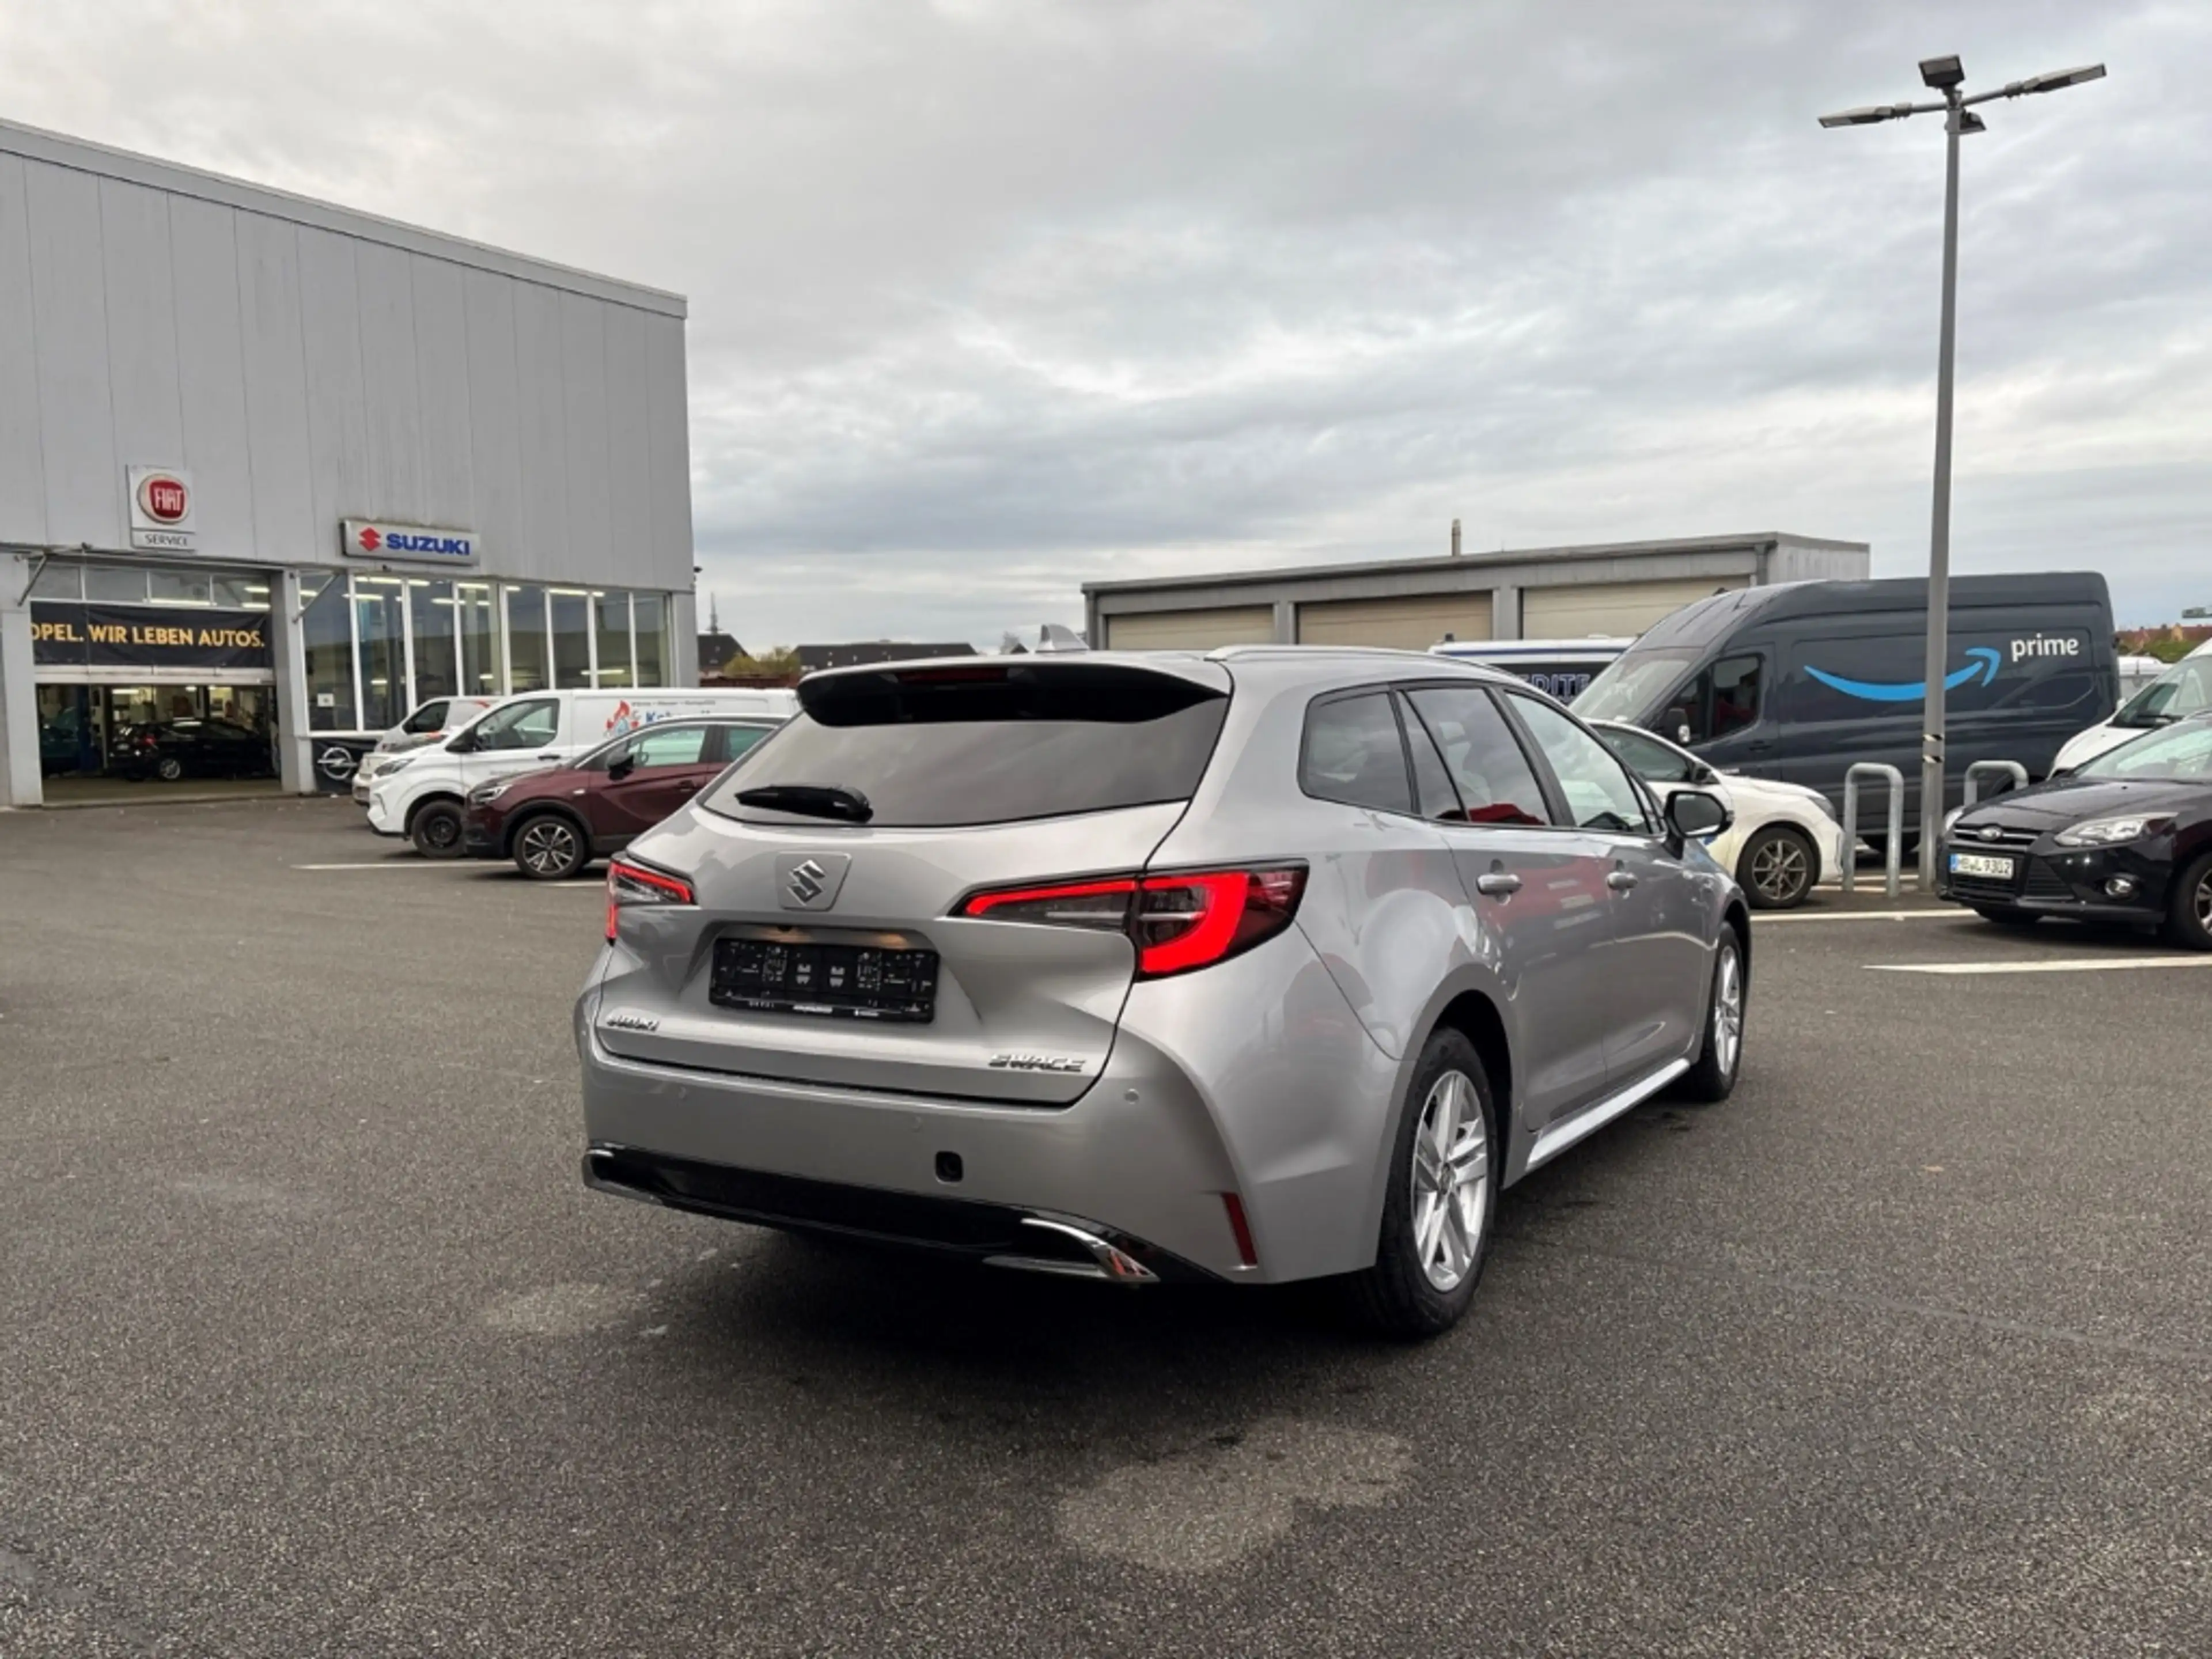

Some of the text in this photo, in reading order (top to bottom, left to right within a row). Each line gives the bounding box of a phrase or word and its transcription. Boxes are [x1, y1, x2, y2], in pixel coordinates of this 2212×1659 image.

[153, 488, 183, 512] FIAT
[386, 533, 470, 556] SUZUKI
[31, 623, 265, 648] OPEL. WIR LEBEN AUTOS.
[2010, 632, 2080, 662] prime
